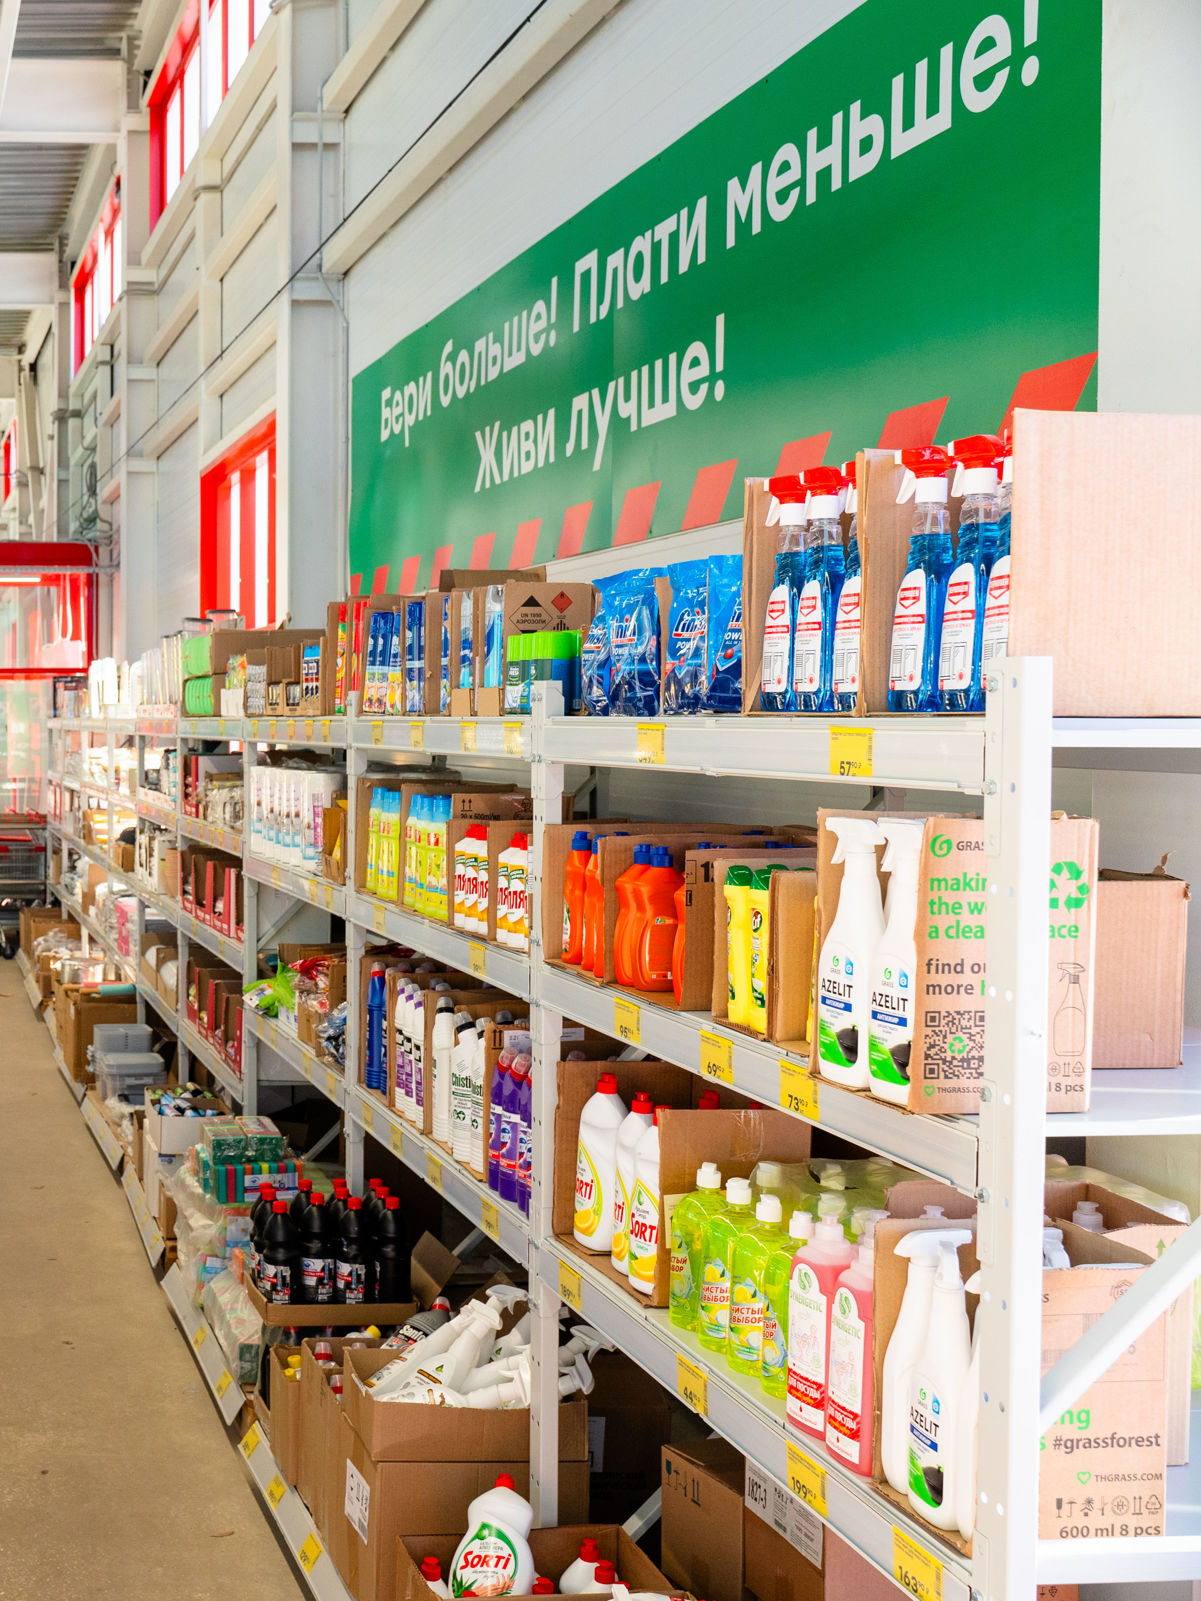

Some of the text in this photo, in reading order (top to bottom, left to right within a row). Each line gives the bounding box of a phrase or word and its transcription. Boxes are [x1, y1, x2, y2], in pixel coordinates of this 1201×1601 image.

[379, 0, 1040, 447] Бери больше! Плати меньше!
[474, 313, 726, 493] Живи лучше!
[840, 760, 851, 776] 57
[956, 840, 985, 851] GRA
[929, 872, 987, 892] maki
[928, 897, 963, 916] the
[928, 920, 1080, 939] a clea ace
[925, 958, 965, 975] find
[821, 977, 853, 999] AZELIT
[925, 982, 974, 996] more
[871, 991, 908, 1013] AZELIT
[707, 1061, 717, 1077] 69
[452, 1072, 471, 1089] Chisti
[1054, 1082, 1062, 1093] 8
[1065, 1083, 1085, 1095] pcs
[937, 1086, 982, 1094] THGRASS.C
[787, 1093, 799, 1111] 73
[576, 1177, 594, 1200] ORTi
[671, 1256, 687, 1265] СТЫЙ
[671, 1265, 684, 1273] БОР
[702, 1285, 730, 1295] ЧИСТЫ
[732, 1316, 764, 1324] ВЫБОР
[400, 1324, 426, 1341] Sanfo
[683, 1386, 694, 1402] 44
[796, 1381, 821, 1399] ПОСУДЫ
[910, 1405, 940, 1437] AZELIT
[1052, 1432, 1161, 1454] #grassforest
[1095, 1472, 1163, 1483] THGRASS.COM
[747, 1476, 768, 1510] 1827-3
[791, 1476, 808, 1499] 199
[1059, 1524, 1161, 1538] 600 ml 8 pcs
[898, 1565, 918, 1594] 163
